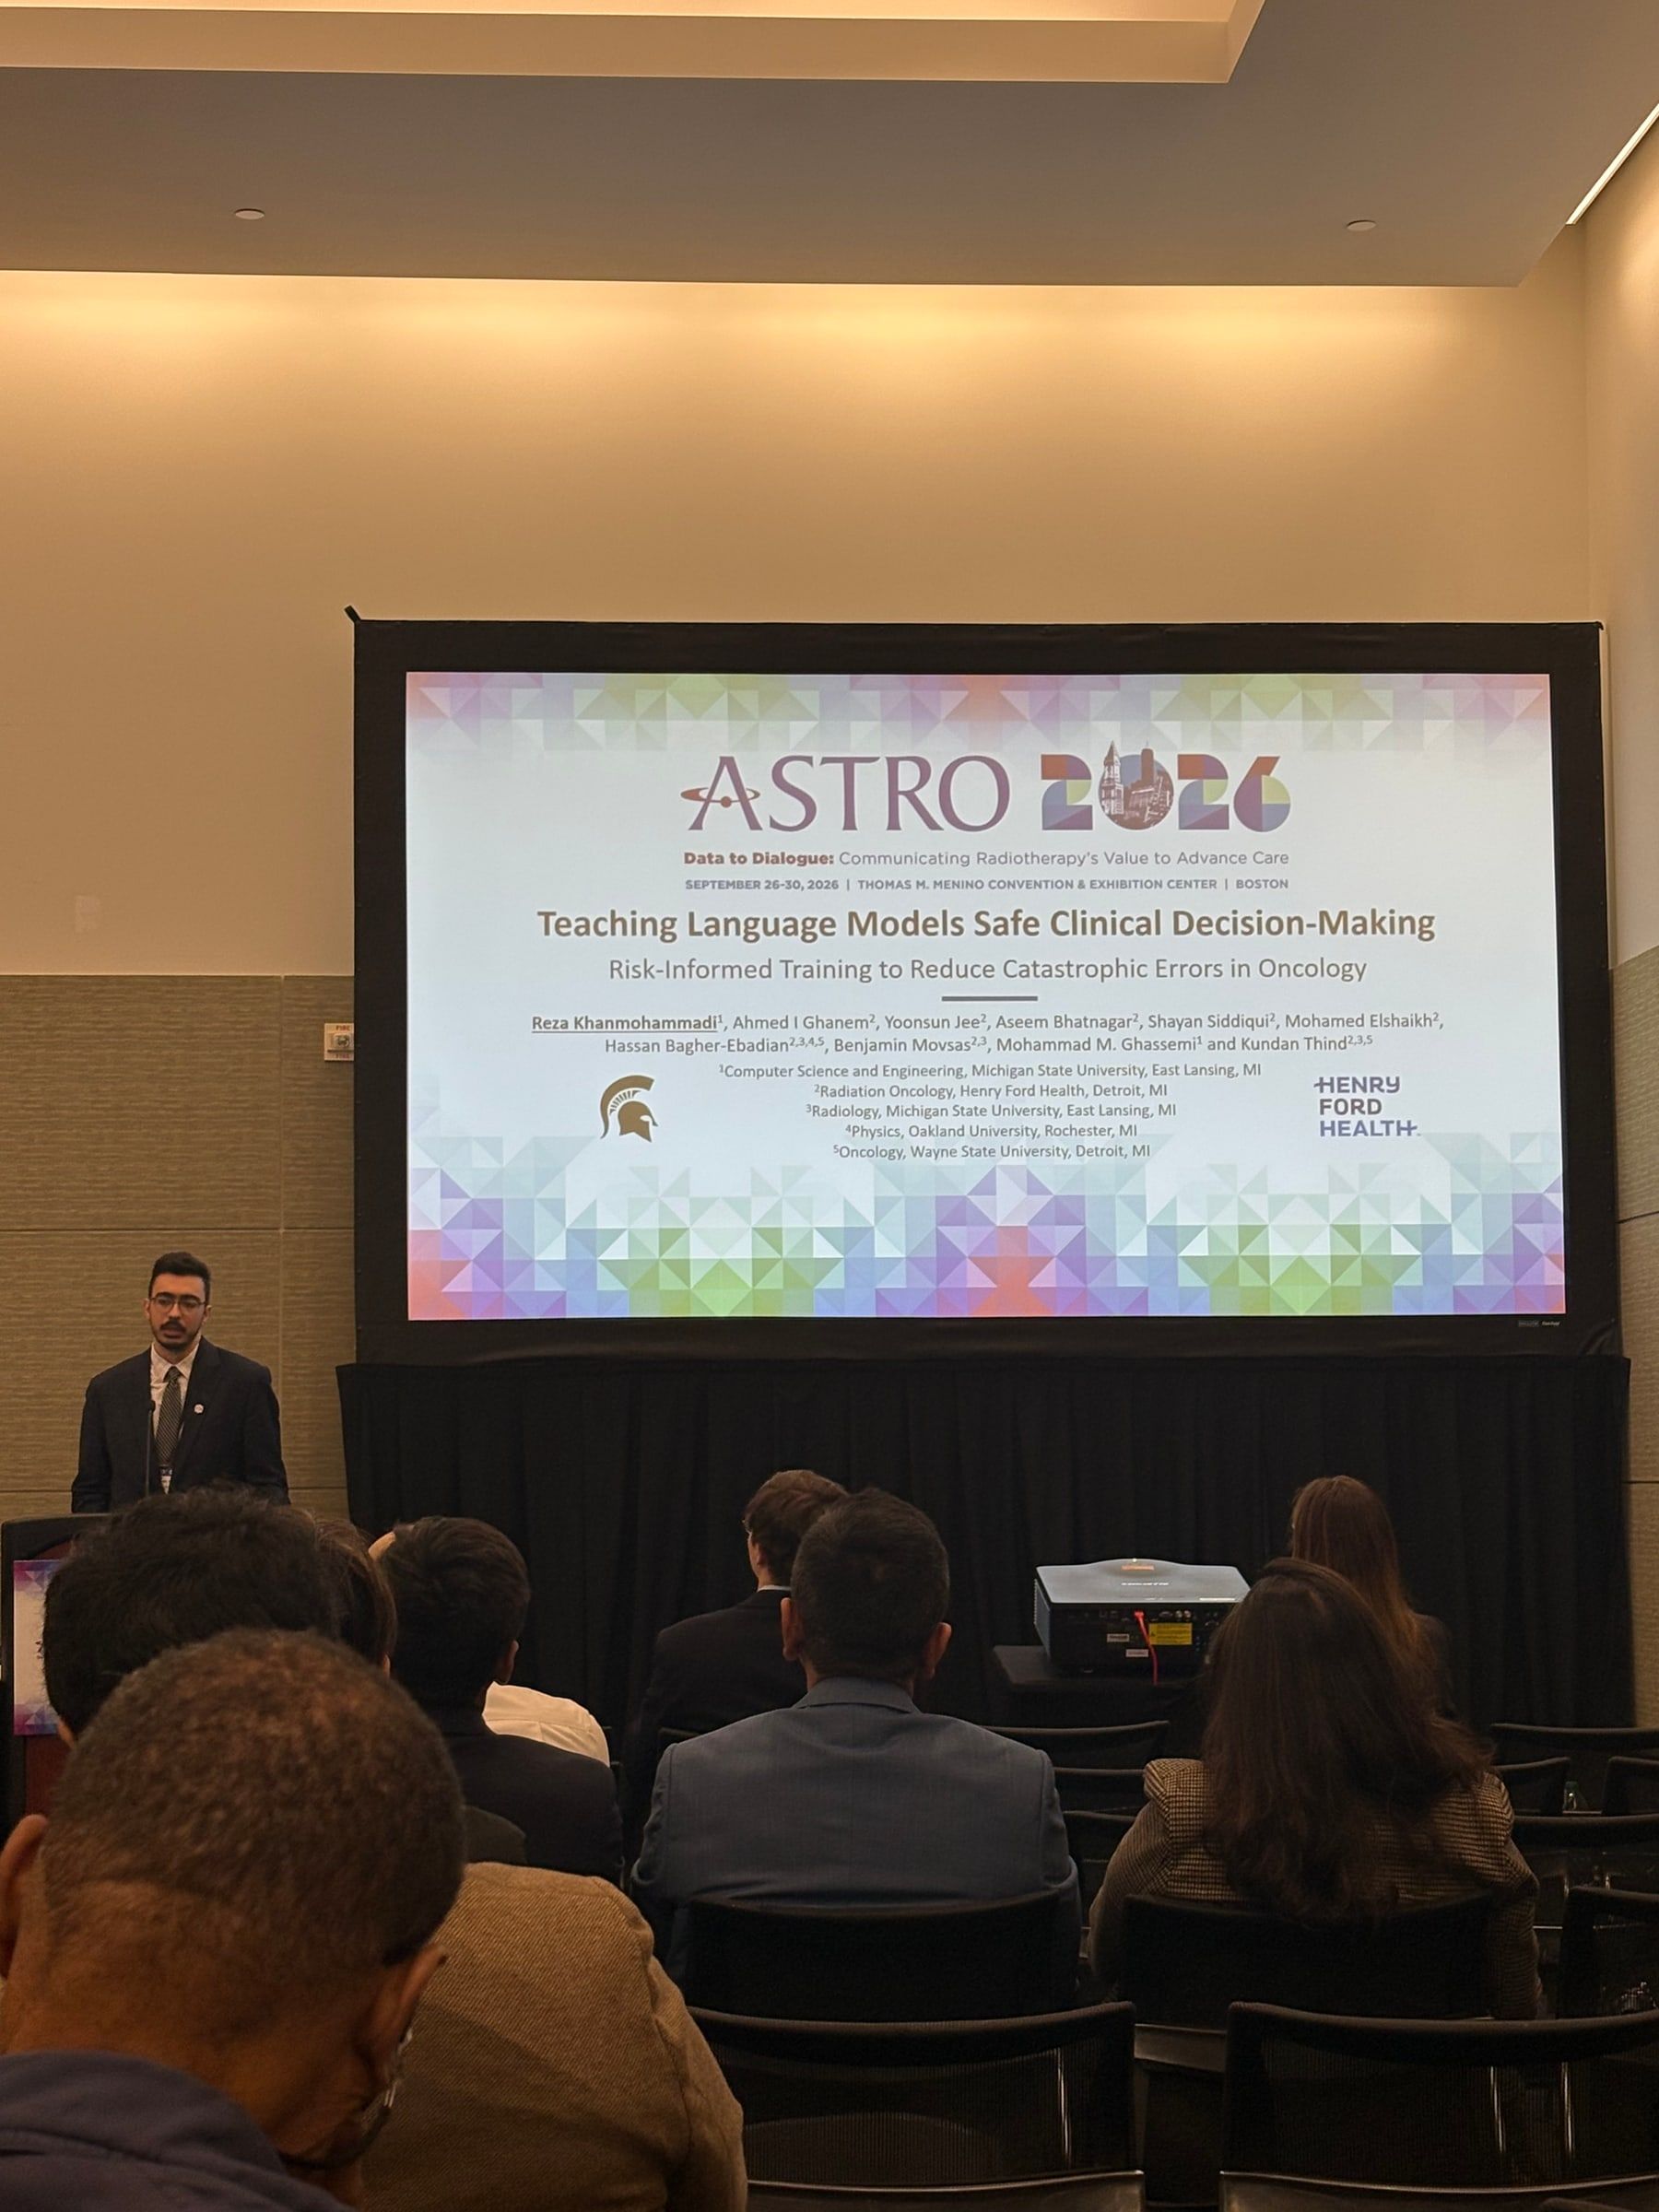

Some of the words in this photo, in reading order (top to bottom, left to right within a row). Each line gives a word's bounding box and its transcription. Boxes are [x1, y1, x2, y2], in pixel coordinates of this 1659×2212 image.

[680, 755, 1010, 832] ASTRO
[1041, 740, 1291, 833] 2026
[684, 853, 724, 865] Data
[729, 853, 747, 865] to
[752, 852, 834, 867] Dialogue:
[840, 852, 970, 867] Communicating
[977, 852, 1099, 867] Radiotherapy's
[1104, 852, 1148, 865] Value
[1154, 853, 1171, 865] to
[1177, 852, 1247, 865] Advance
[1253, 851, 1288, 864] Care
[686, 879, 761, 889] SEPTEMBER
[764, 879, 805, 891] 26-30,
[807, 879, 839, 889] 2026
[857, 879, 912, 889] THOMAS
[916, 880, 929, 889] M.
[933, 879, 984, 889] MENINO
[988, 879, 1074, 889] CONVENTION
[1077, 879, 1086, 889] &
[1089, 879, 1163, 889] EXHIBITION
[1167, 879, 1217, 889] CENTER
[1236, 879, 1288, 889] BOSTON
[537, 910, 677, 943] Teaching
[688, 912, 836, 944] Language
[848, 910, 964, 936] Models
[974, 909, 1040, 936] Safe
[1051, 909, 1160, 936] Clinical
[1173, 908, 1435, 942] Decision-Making
[610, 958, 771, 979] Risk-Informed
[779, 959, 872, 983] Training
[878, 961, 902, 979] to
[912, 958, 995, 979] Reduce
[1004, 958, 1147, 982] Catastrophic
[1156, 959, 1223, 978] Errors
[1231, 959, 1250, 978] in
[1259, 957, 1367, 982] Oncology
[532, 1016, 569, 1030] Reza
[733, 1015, 789, 1030] Ahmed
[885, 1016, 950, 1030] Yoonsun
[995, 1016, 1048, 1030] Aseem
[1148, 1014, 1203, 1031] Shayan
[1286, 1015, 1364, 1029] Mohamed
[606, 1040, 660, 1053] Hassan
[835, 1038, 907, 1055] Benjamin
[997, 1038, 1091, 1052] Mohammad
[1097, 1038, 1116, 1052] M.
[1207, 1037, 1236, 1051] and
[1241, 1037, 1300, 1051] Kundan
[797, 1065, 849, 1077] Science
[853, 1065, 878, 1077] and
[883, 1065, 968, 1080] Engineering,
[971, 1064, 1034, 1079] Michigan
[1038, 1065, 1073, 1077] State
[1076, 1064, 1147, 1079] University,
[1152, 1064, 1180, 1076] East
[1184, 1064, 1239, 1078] Lansing,
[1243, 1064, 1261, 1076] MI
[888, 1084, 956, 1100] Oncology,
[960, 1084, 1002, 1100] Henry
[1006, 1084, 1035, 1097] Ford
[1040, 1084, 1088, 1099] Health,
[1093, 1084, 1145, 1099] Detroit,
[1149, 1084, 1167, 1096] MI
[1313, 1077, 1400, 1093] HENRY
[887, 1104, 948, 1120] Michigan
[952, 1104, 987, 1117] State
[992, 1103, 1063, 1119] University,
[1067, 1104, 1095, 1116] East
[1099, 1103, 1154, 1119] Lansing,
[1159, 1104, 1176, 1116] MI
[1319, 1098, 1382, 1115] FORD
[909, 1124, 965, 1137] Oakland
[967, 1124, 1041, 1139] University,
[1042, 1124, 1115, 1139] Rochester,
[1119, 1124, 1136, 1136] MI
[1320, 1120, 1418, 1136] HEALTH
[911, 1145, 958, 1160] Wayne
[961, 1145, 997, 1158] State
[1000, 1144, 1072, 1159] University,
[1077, 1144, 1127, 1159] Detroit,
[1133, 1145, 1149, 1157] MI
